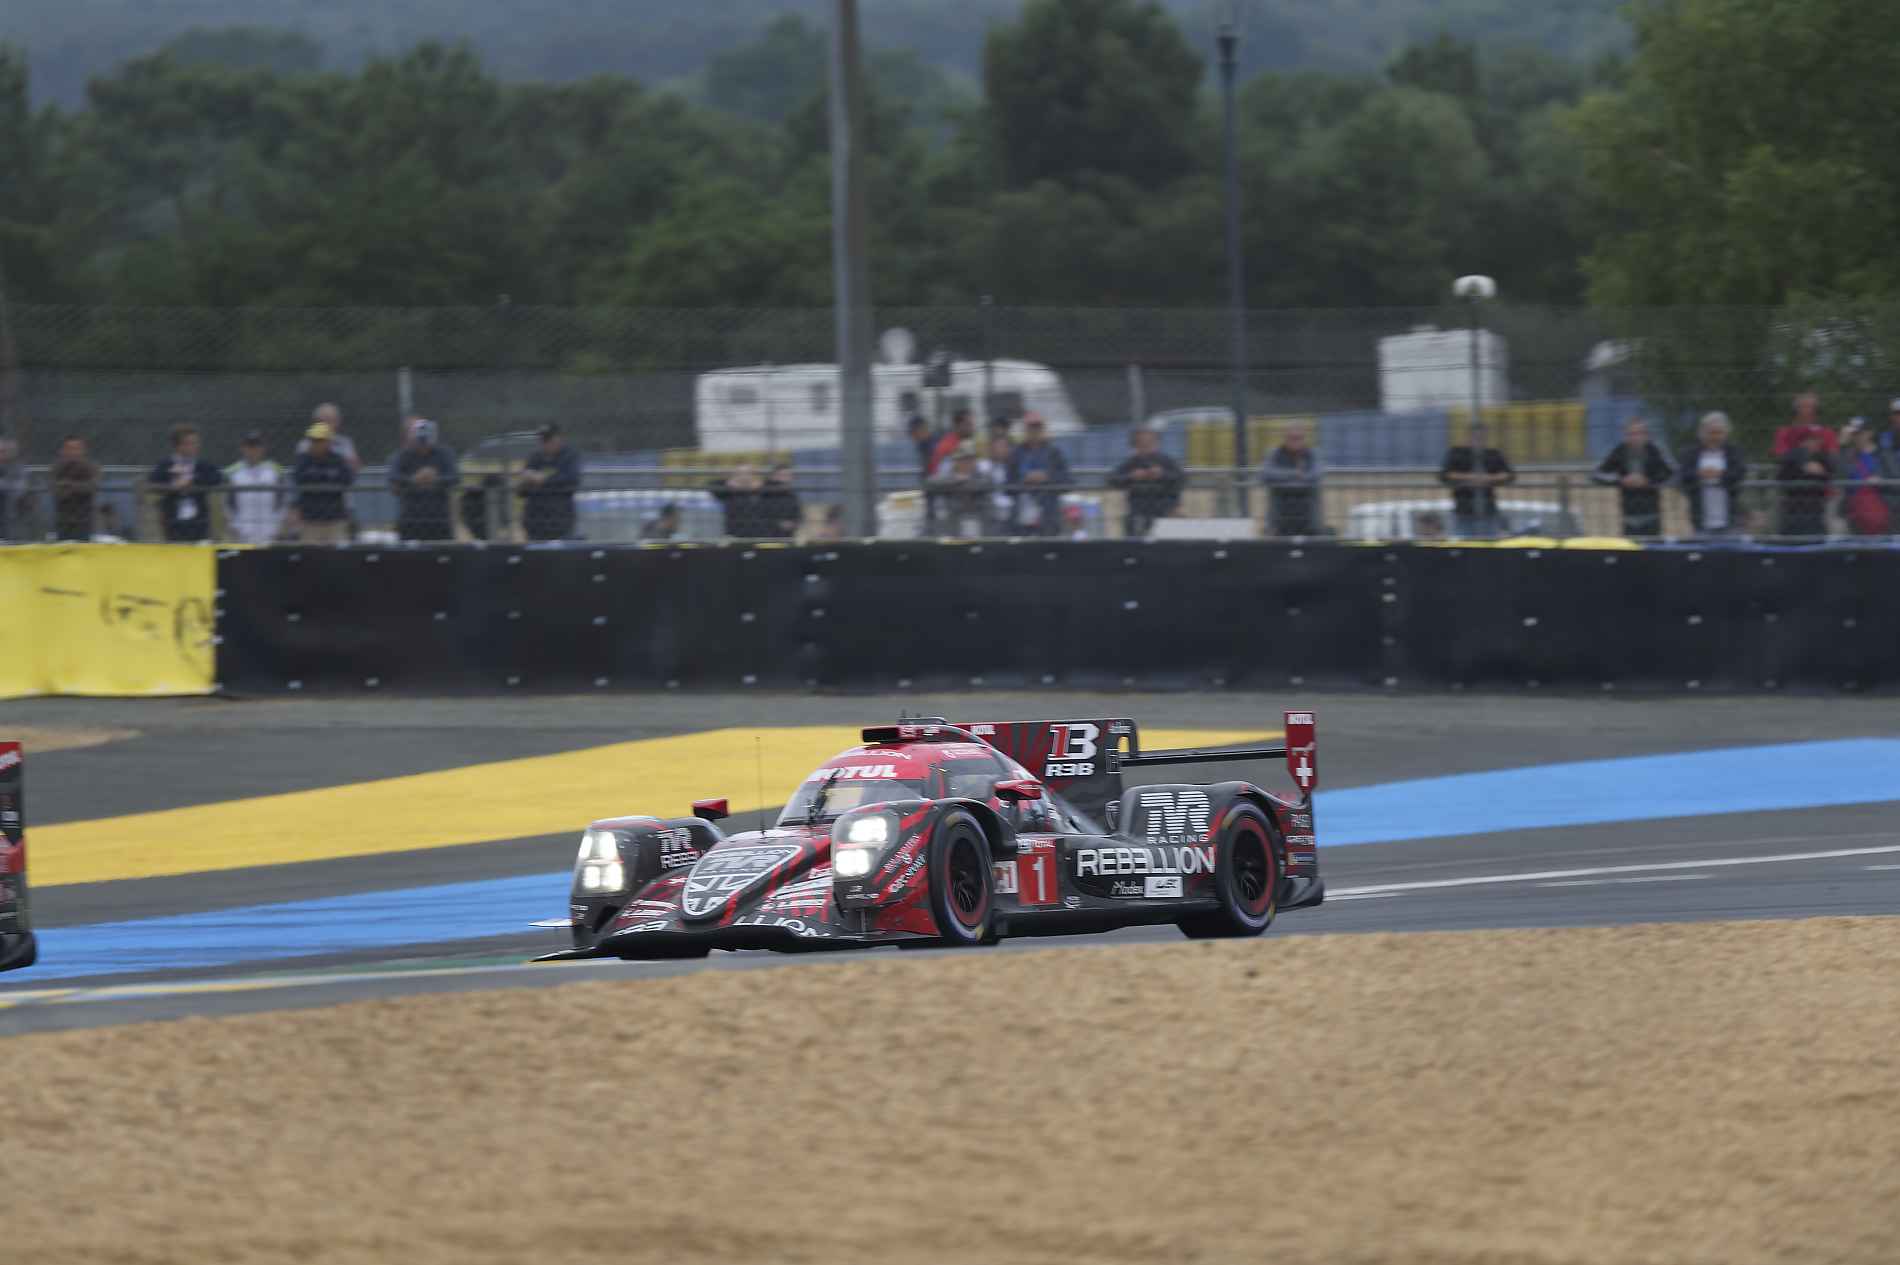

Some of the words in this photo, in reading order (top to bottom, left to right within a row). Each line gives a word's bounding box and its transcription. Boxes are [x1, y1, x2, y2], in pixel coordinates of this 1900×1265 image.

[1139, 791, 1211, 835] TVR
[1146, 835, 1210, 845] RACING
[1031, 856, 1046, 901] 1
